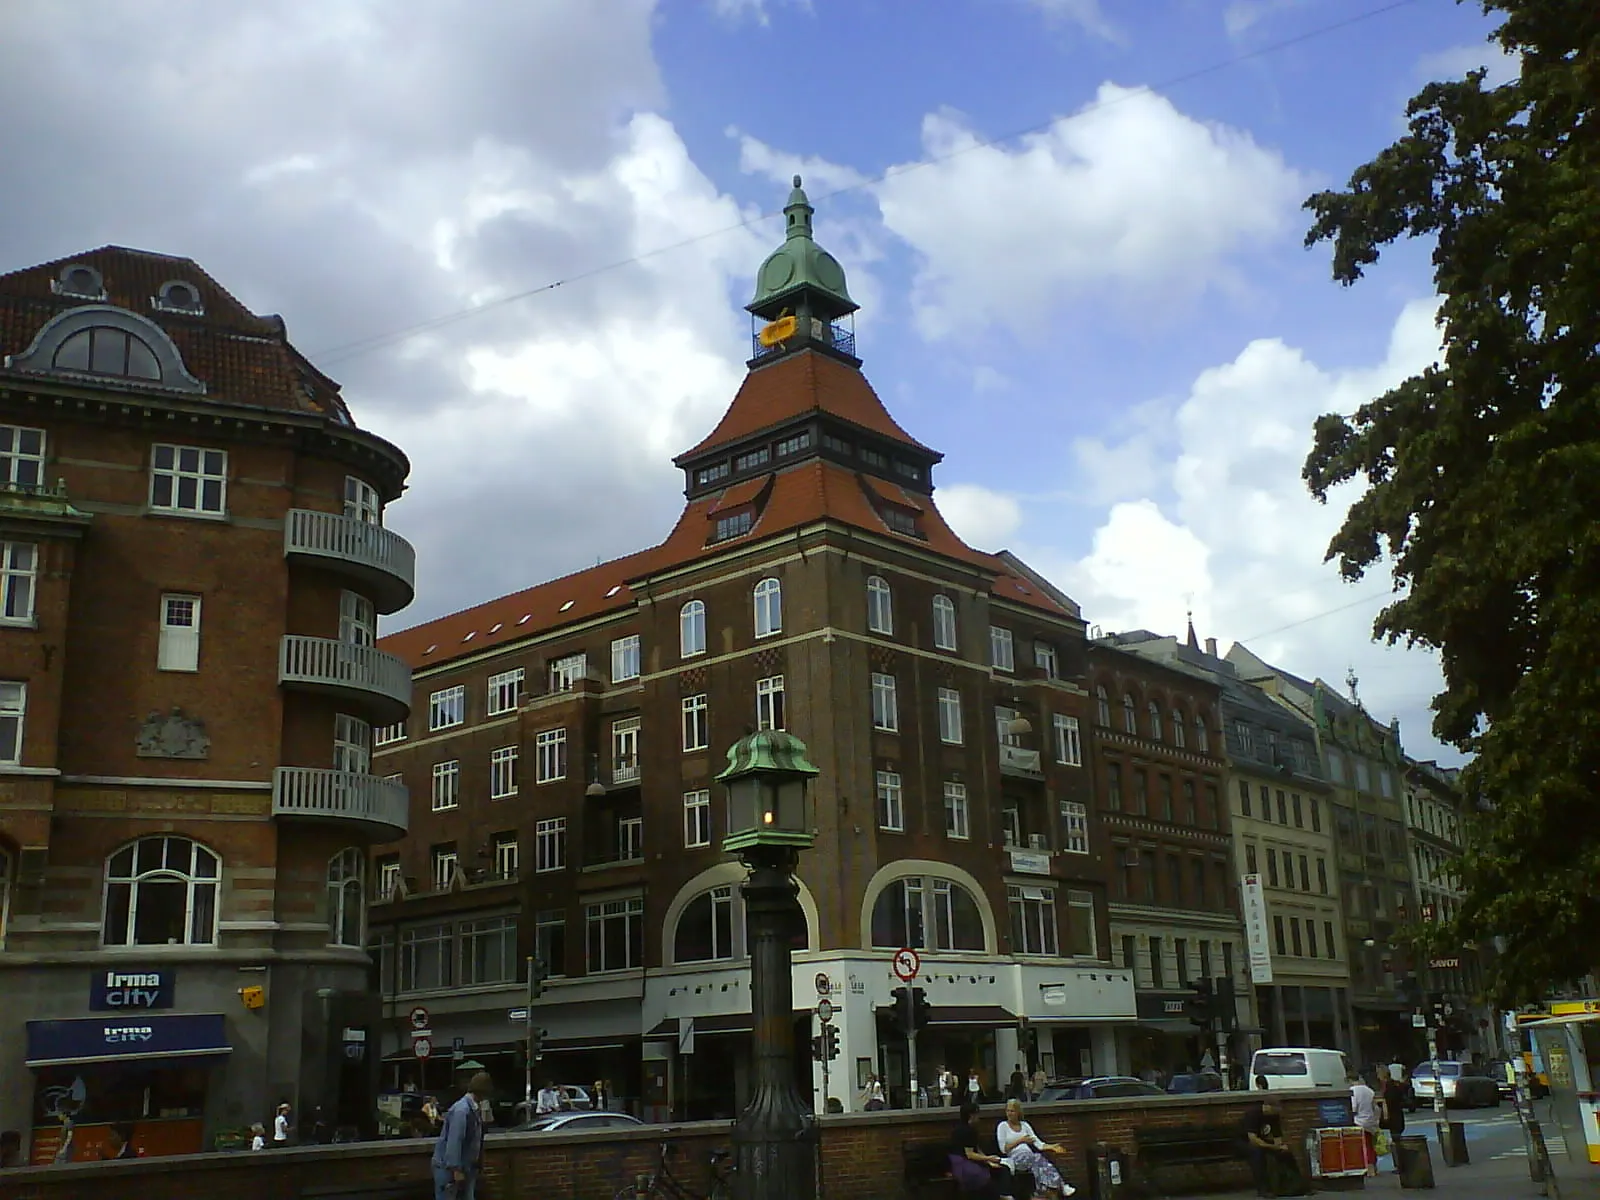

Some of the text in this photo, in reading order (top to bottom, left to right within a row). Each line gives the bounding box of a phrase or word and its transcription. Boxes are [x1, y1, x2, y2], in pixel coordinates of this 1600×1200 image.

[1429, 958, 1459, 968] SAVOY
[106, 972, 160, 987] Irma
[106, 988, 160, 1007] city
[104, 1027, 152, 1035] Irma
[105, 1034, 152, 1043] city
